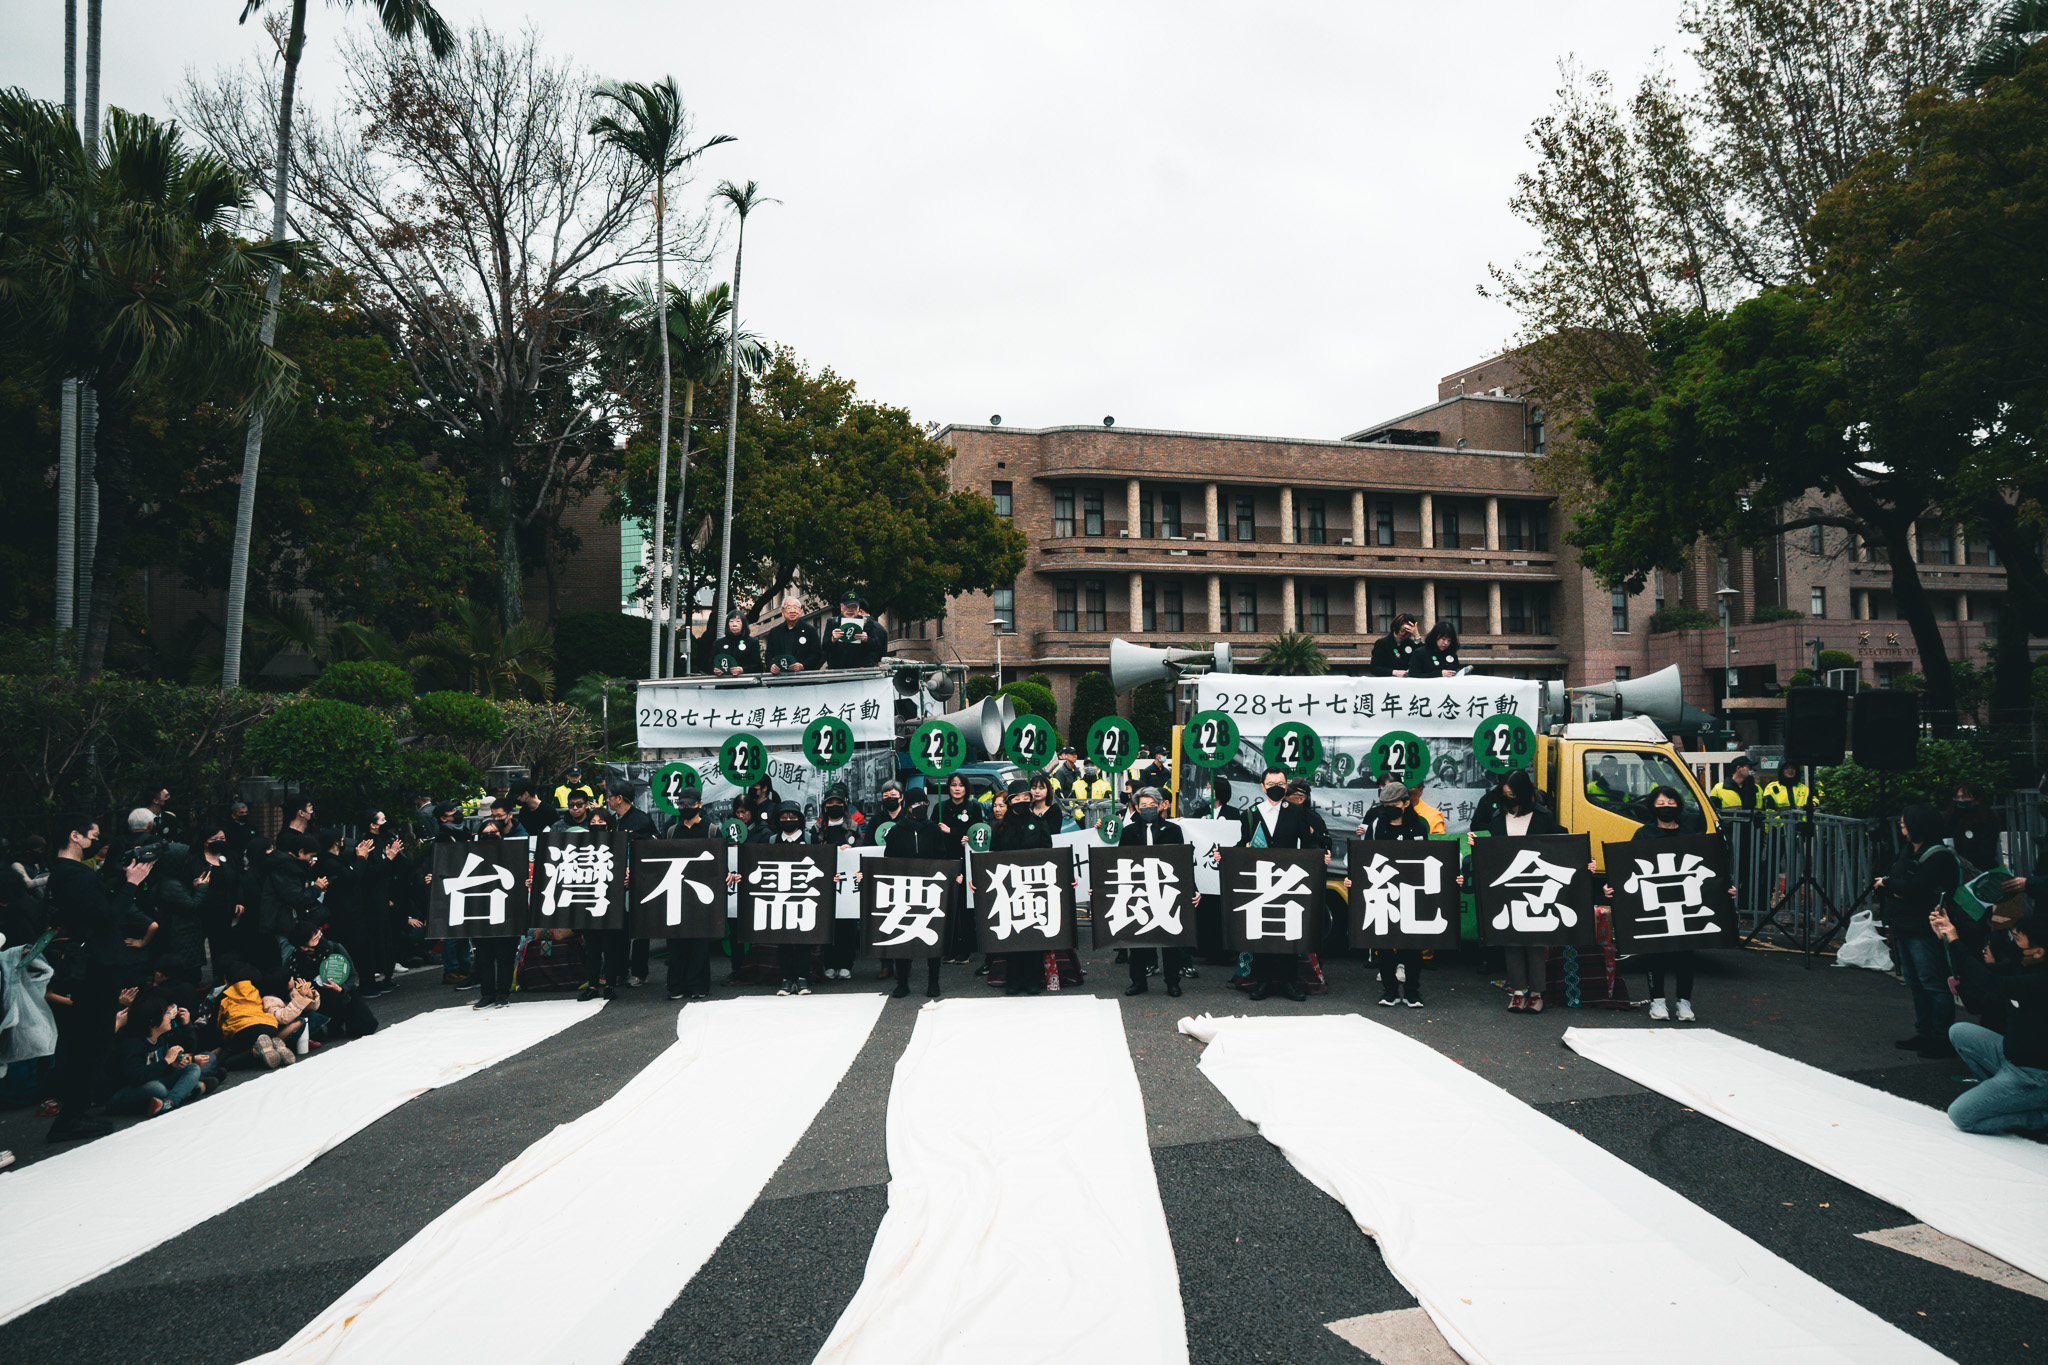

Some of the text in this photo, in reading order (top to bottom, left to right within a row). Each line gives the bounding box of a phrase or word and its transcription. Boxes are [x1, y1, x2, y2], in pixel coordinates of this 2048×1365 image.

[1858, 647, 1902, 656] EXECUTIVE
[639, 698, 880, 729] 228七十七週年紀念行動
[1216, 692, 1518, 720] 228七十七週年紀念行動
[811, 729, 846, 756] 228
[921, 731, 958, 758] 228
[1012, 728, 1047, 756] 228
[1094, 730, 1129, 756] 228
[1191, 720, 1230, 749] 228
[1273, 734, 1315, 763] 228
[1484, 726, 1527, 757] 228
[727, 745, 760, 770] 228
[1378, 741, 1421, 771] 228
[1104, 821, 1119, 833] 228
[443, 853, 514, 926] 台
[541, 842, 613, 917] 灣
[640, 851, 714, 926] 不
[749, 856, 824, 931] 需
[871, 872, 947, 945] 要
[986, 861, 1062, 940] 獨
[1104, 858, 1183, 939] 裁
[1233, 860, 1312, 940] 者
[1362, 853, 1448, 935] 紀
[1490, 850, 1577, 931] 念
[1624, 853, 1721, 939] 堂
